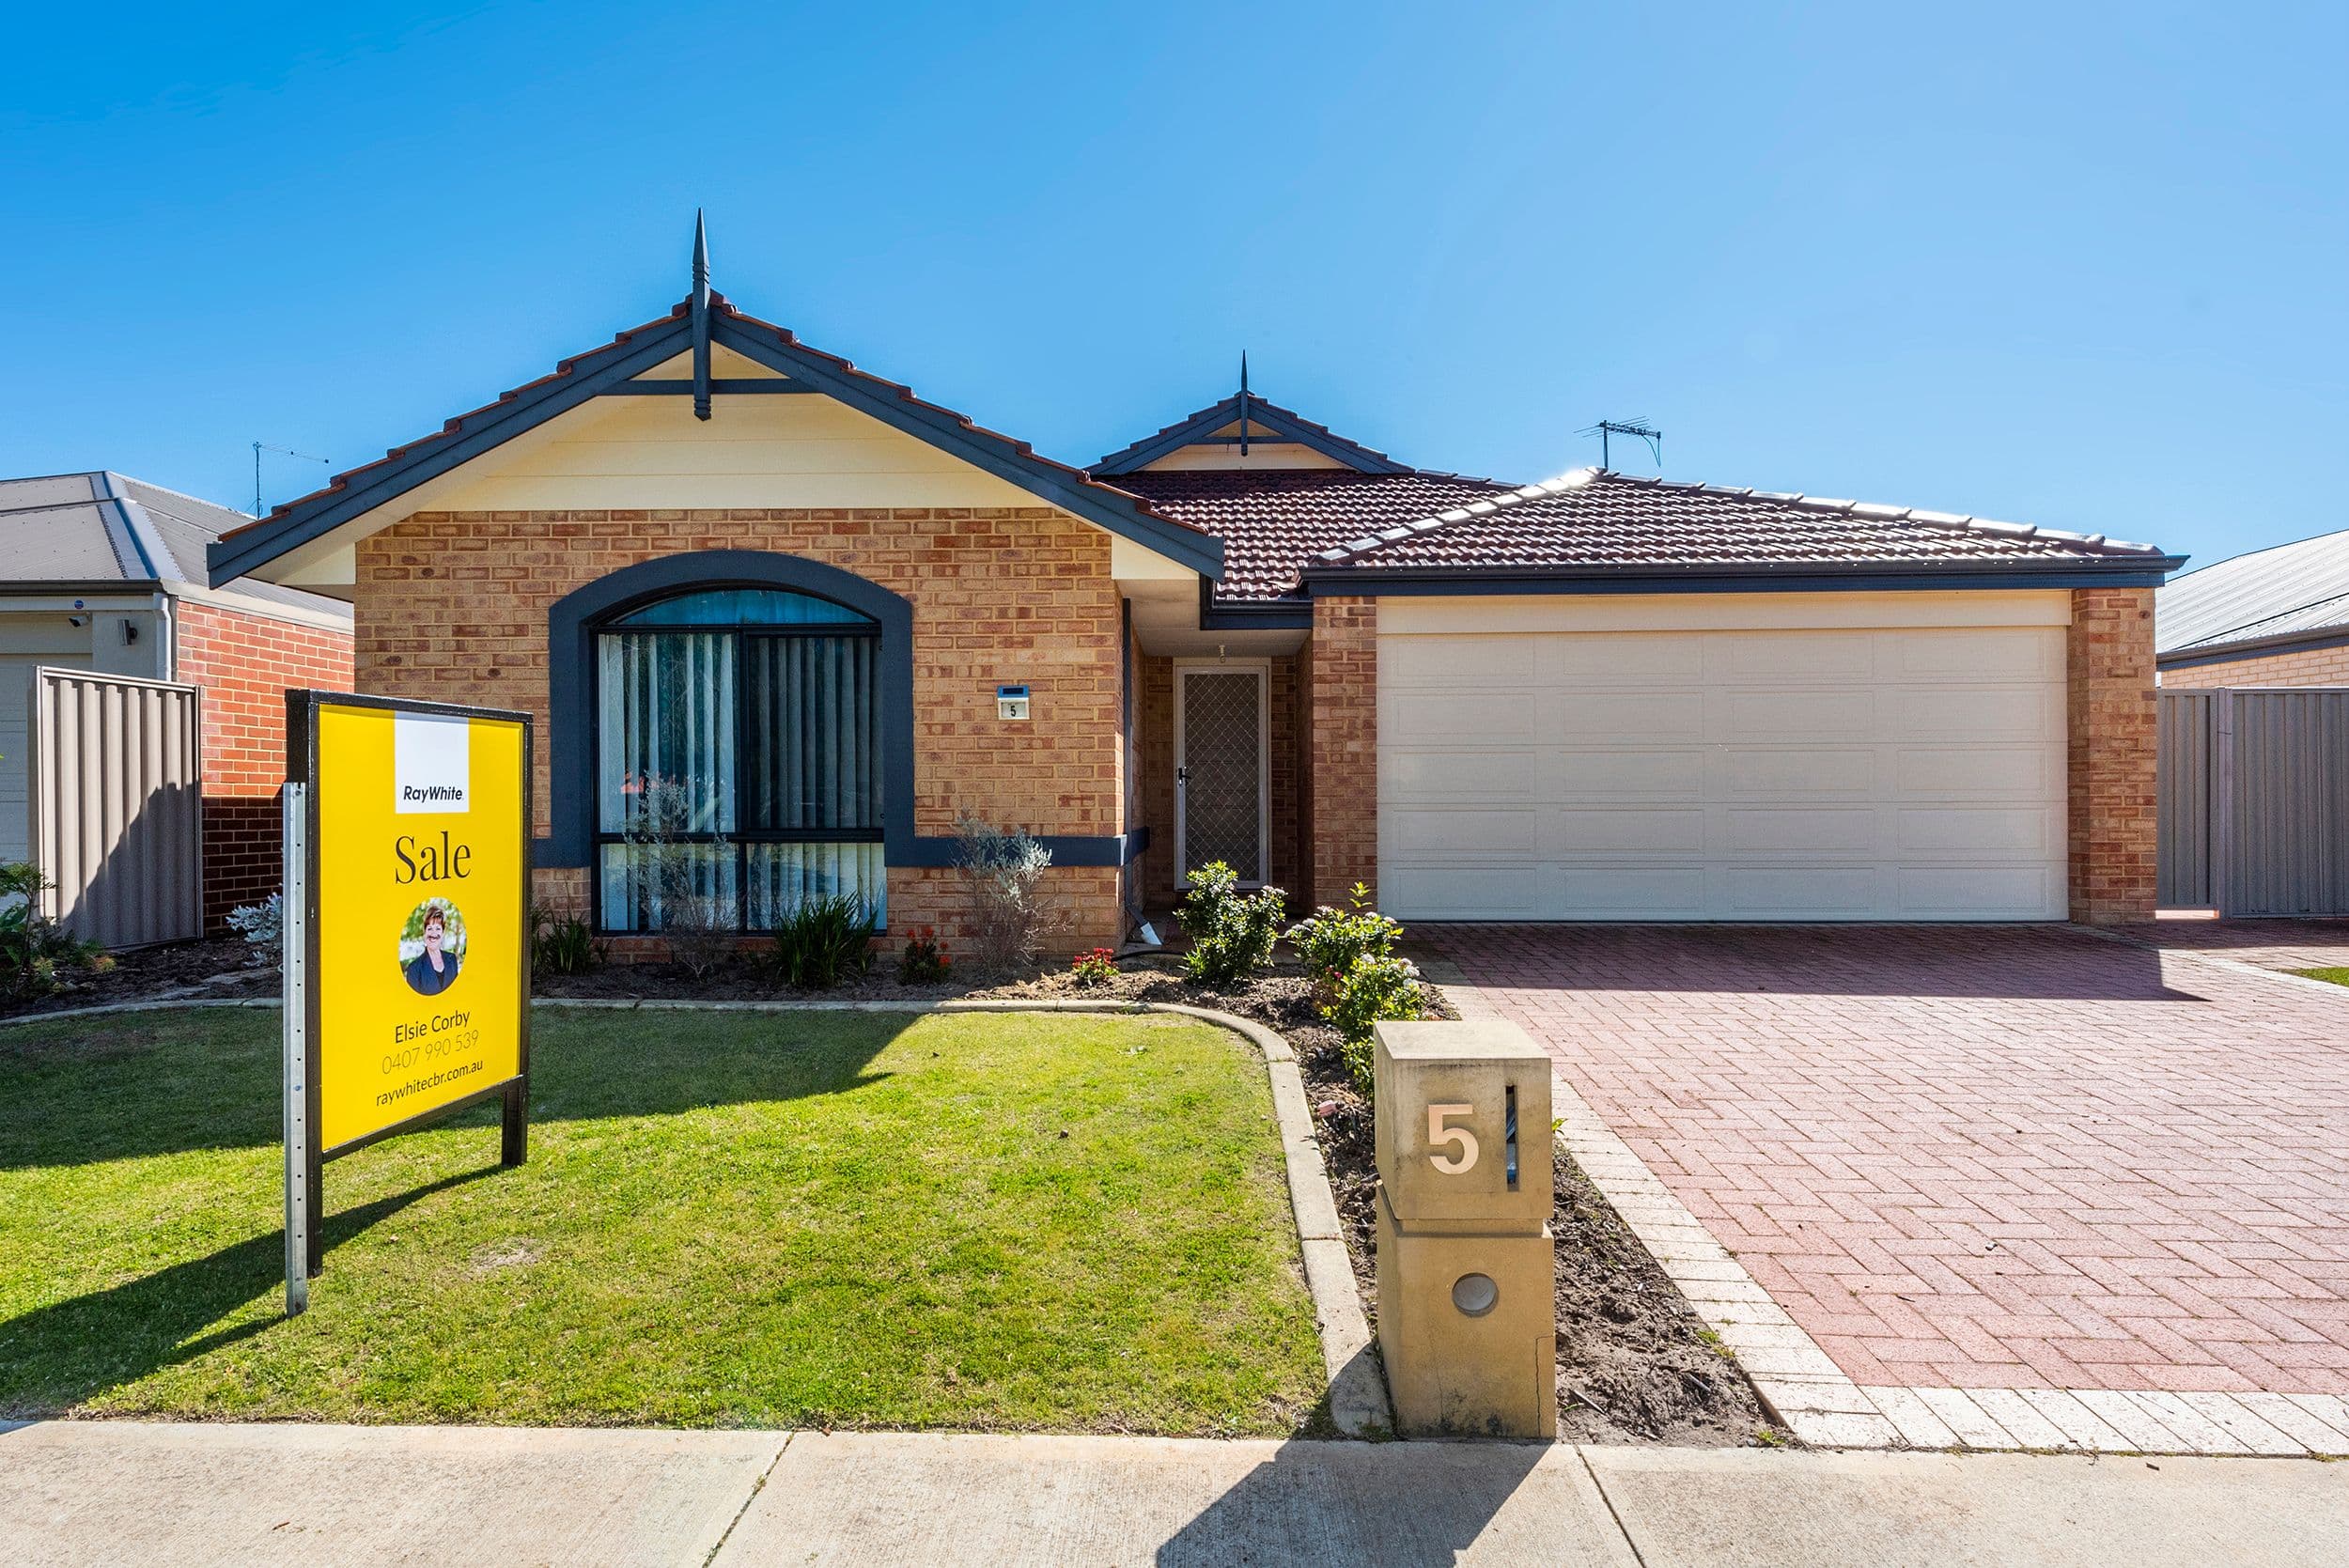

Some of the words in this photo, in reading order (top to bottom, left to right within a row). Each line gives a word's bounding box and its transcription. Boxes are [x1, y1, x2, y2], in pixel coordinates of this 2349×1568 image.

[1010, 705, 1017, 717] 5
[403, 785, 463, 803] RayWhite
[395, 830, 471, 884] Sale
[395, 1020, 428, 1044] Elsie
[431, 1010, 471, 1032] Corby
[381, 1047, 421, 1075] 0407
[425, 1038, 451, 1061] 990
[456, 1030, 479, 1052] 539
[376, 1061, 483, 1107] raywhitecbr.com.au
[1427, 1103, 1480, 1175] 5
